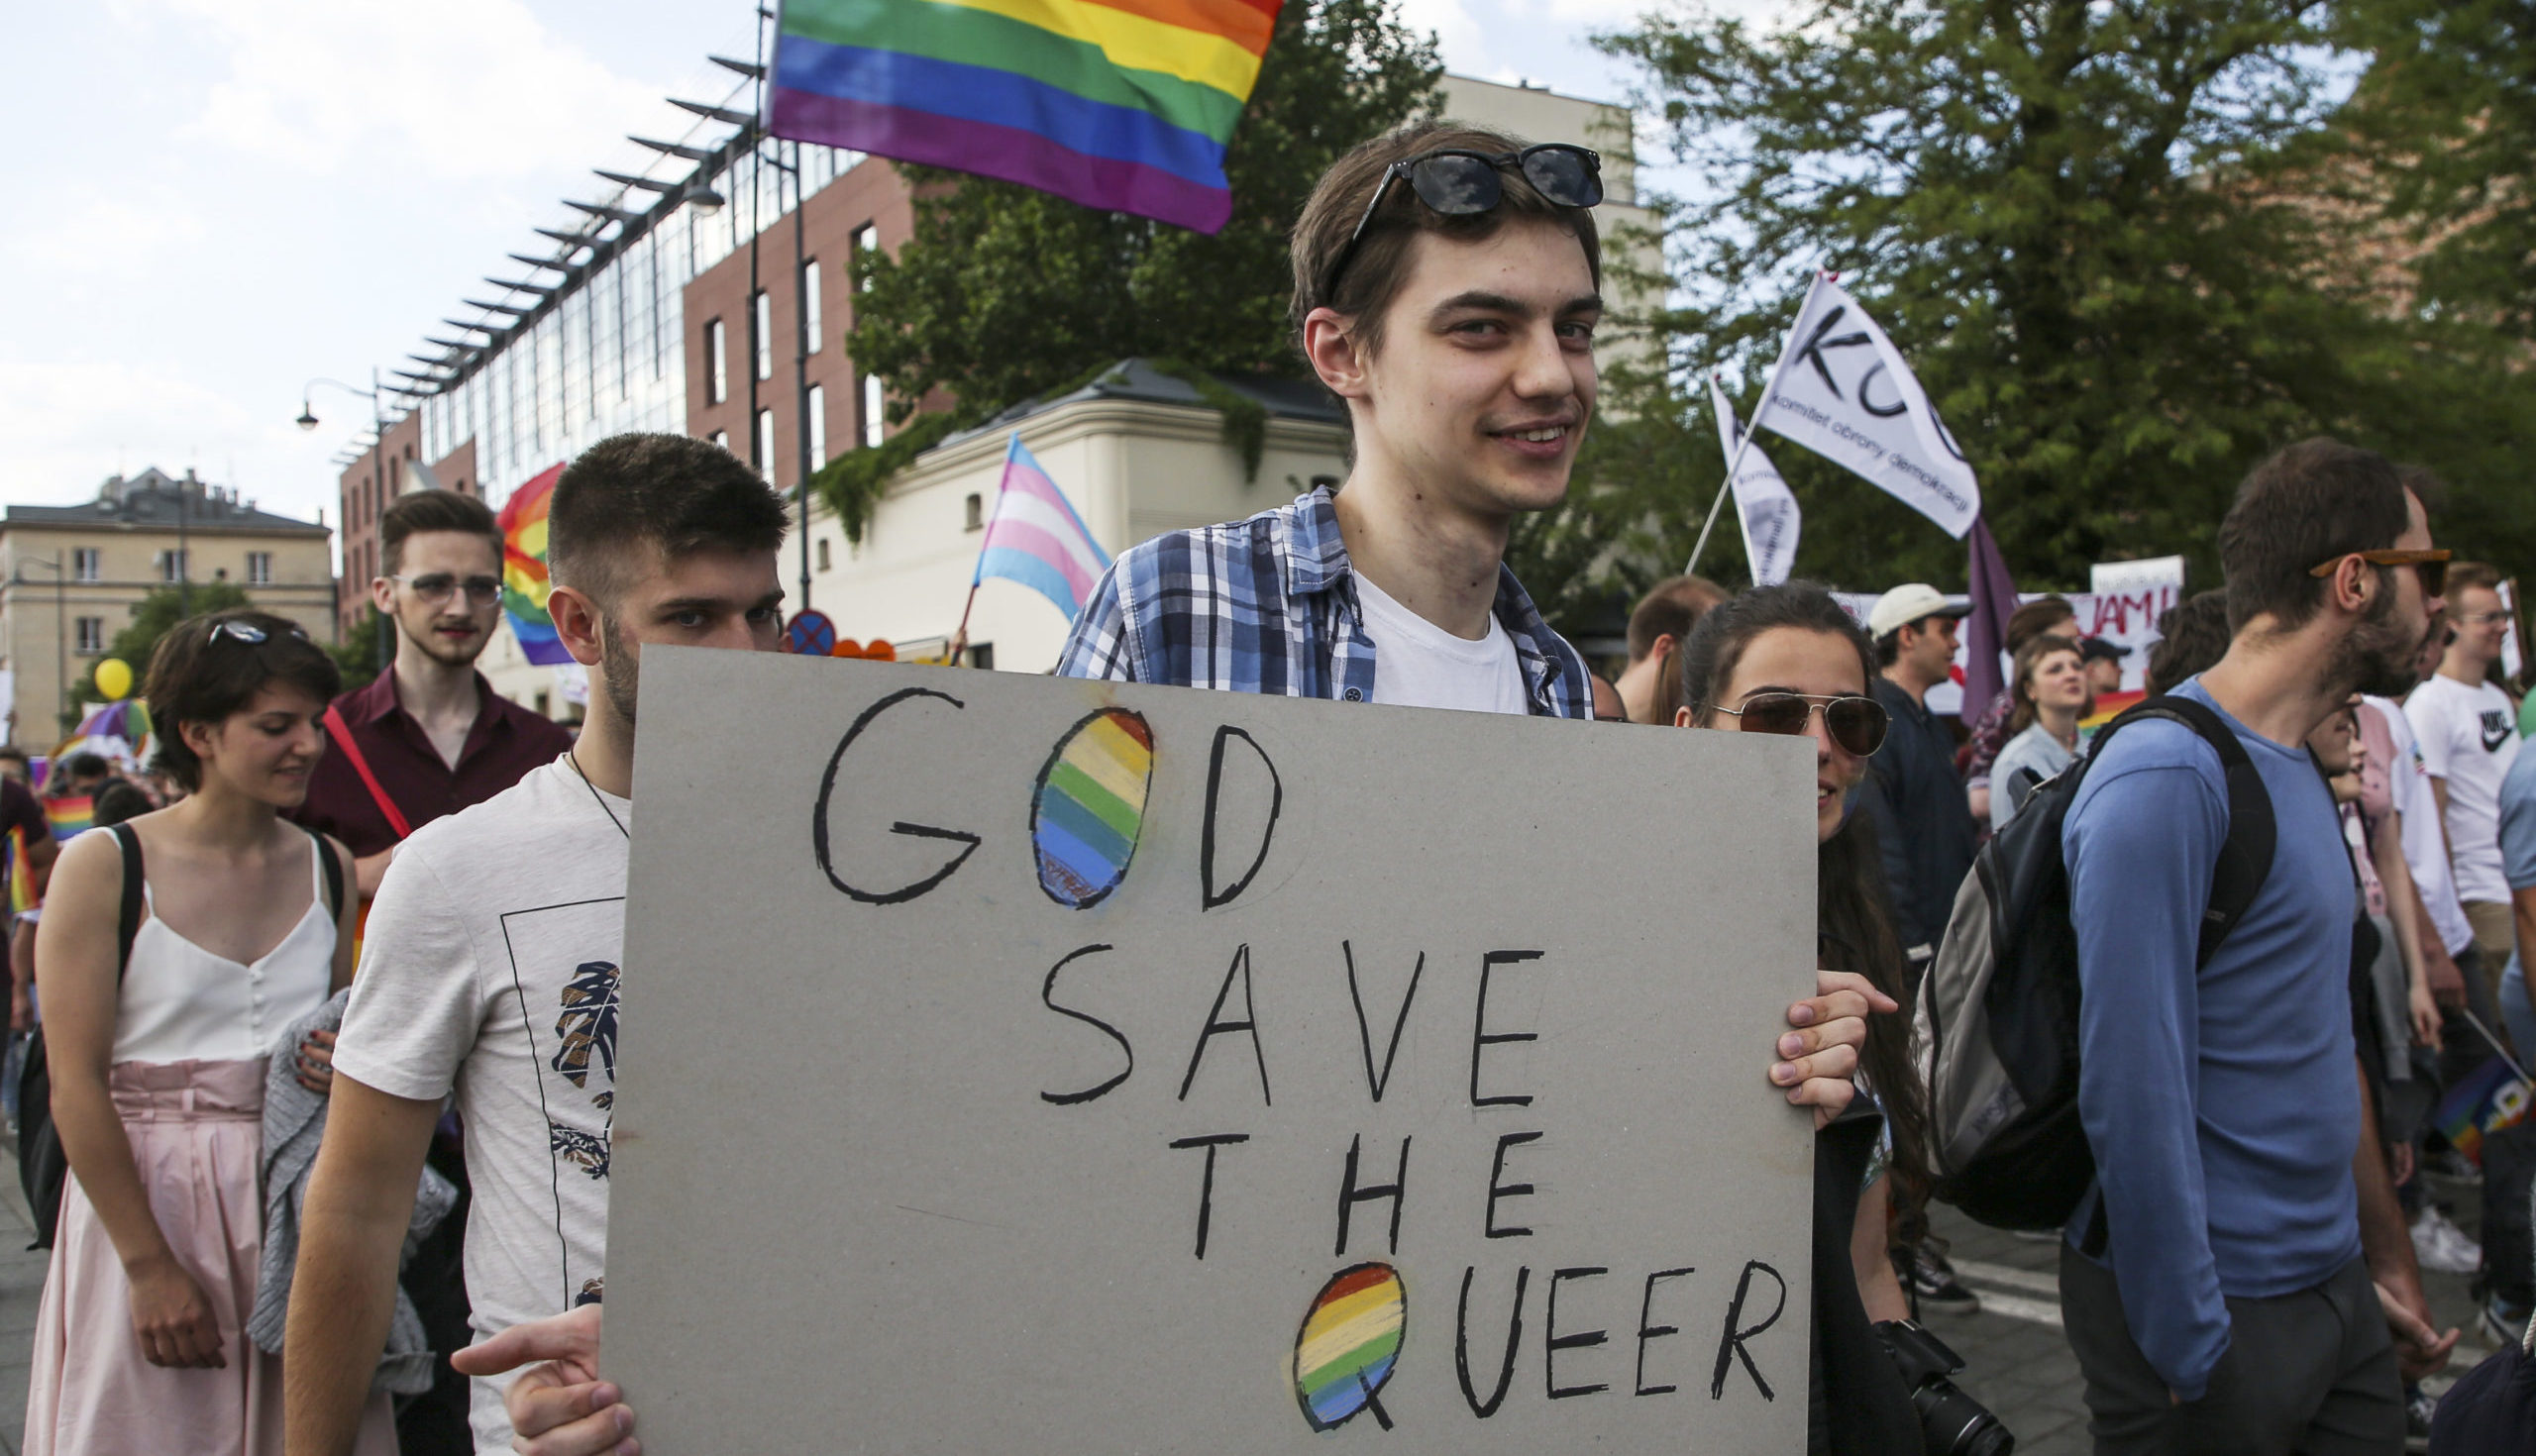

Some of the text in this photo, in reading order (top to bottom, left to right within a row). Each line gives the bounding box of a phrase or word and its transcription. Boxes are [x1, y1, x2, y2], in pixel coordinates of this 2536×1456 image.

[1770, 391, 1967, 512] komitet obrony demokracji
[812, 686, 1282, 911] GOD
[1040, 939, 1545, 1107] SAVE
[1169, 1130, 1544, 1261] THE
[1292, 1259, 1787, 1432] QUEER
